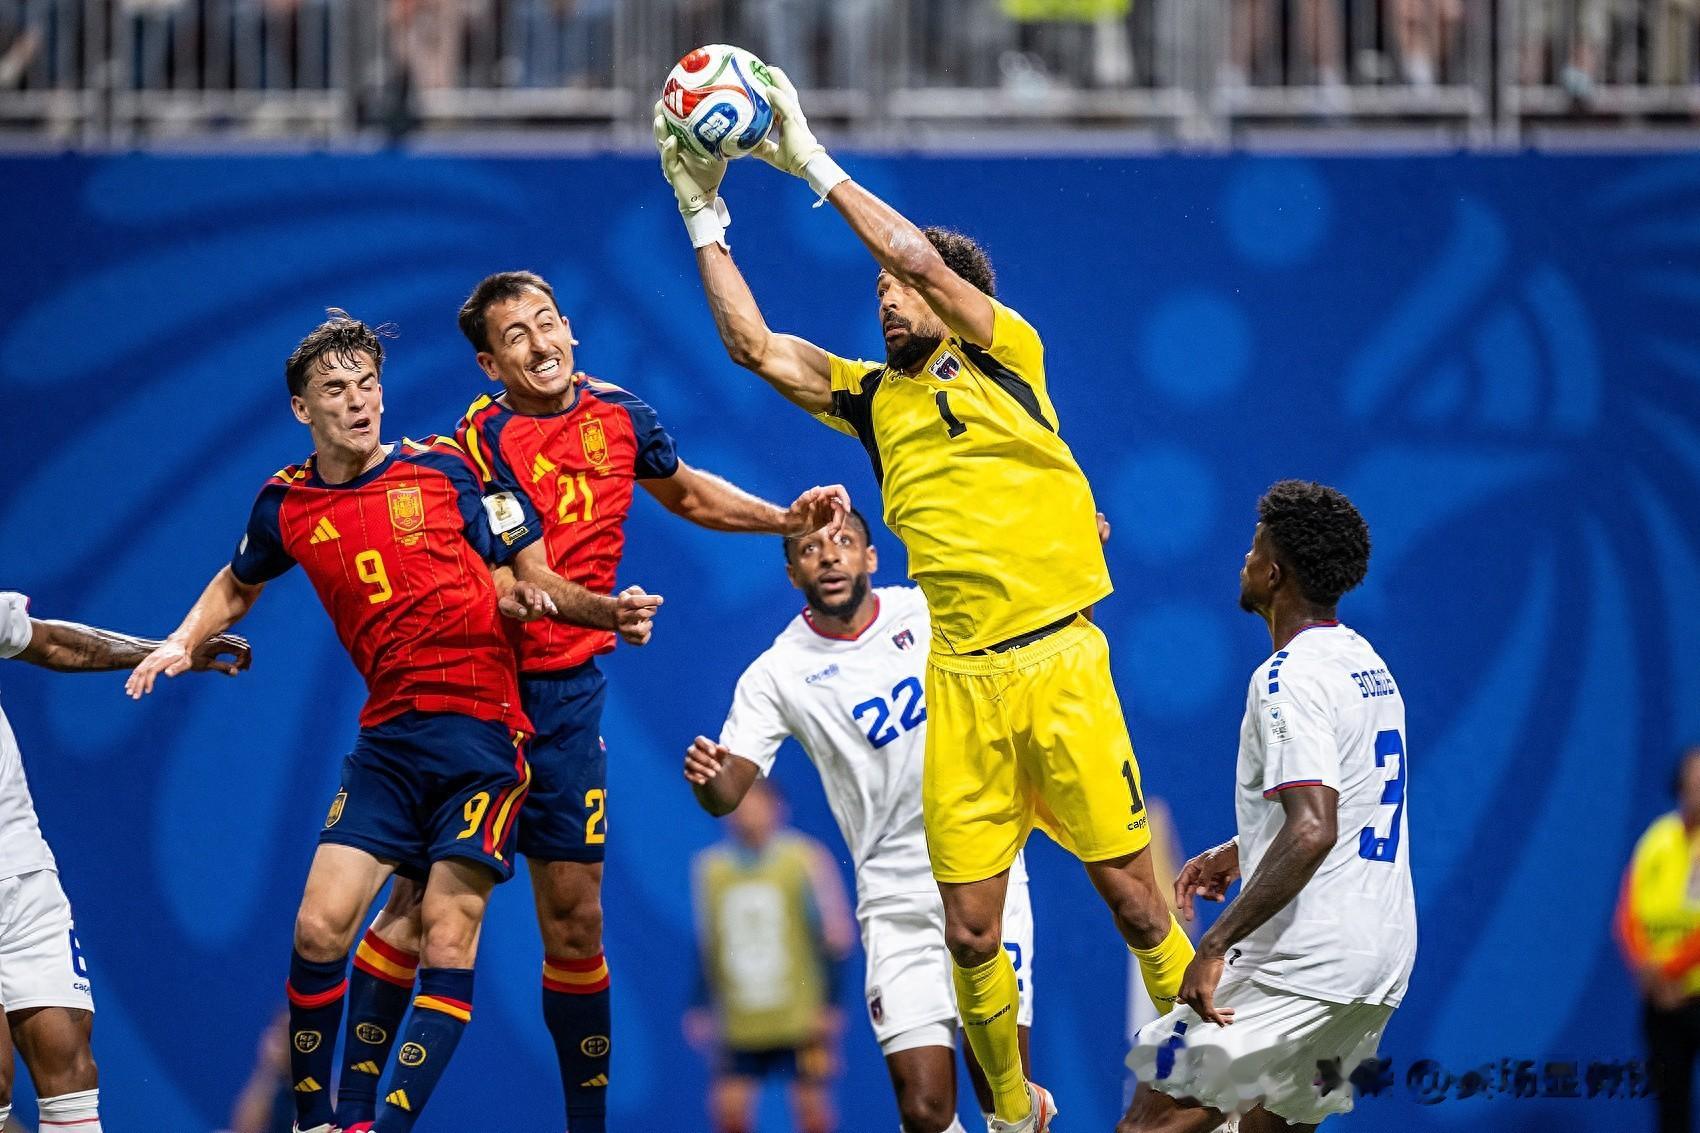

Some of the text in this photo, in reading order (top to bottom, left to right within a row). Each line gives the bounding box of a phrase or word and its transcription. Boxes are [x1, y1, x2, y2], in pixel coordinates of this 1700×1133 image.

[935, 390, 968, 439] 1
[556, 470, 595, 525] 21
[355, 549, 393, 605] 9
[852, 676, 927, 749] 22
[1122, 760, 1144, 815] 1
[1358, 729, 1408, 864] 3
[456, 791, 490, 840] 9
[584, 788, 608, 845] 2
[1127, 816, 1147, 830] cape
